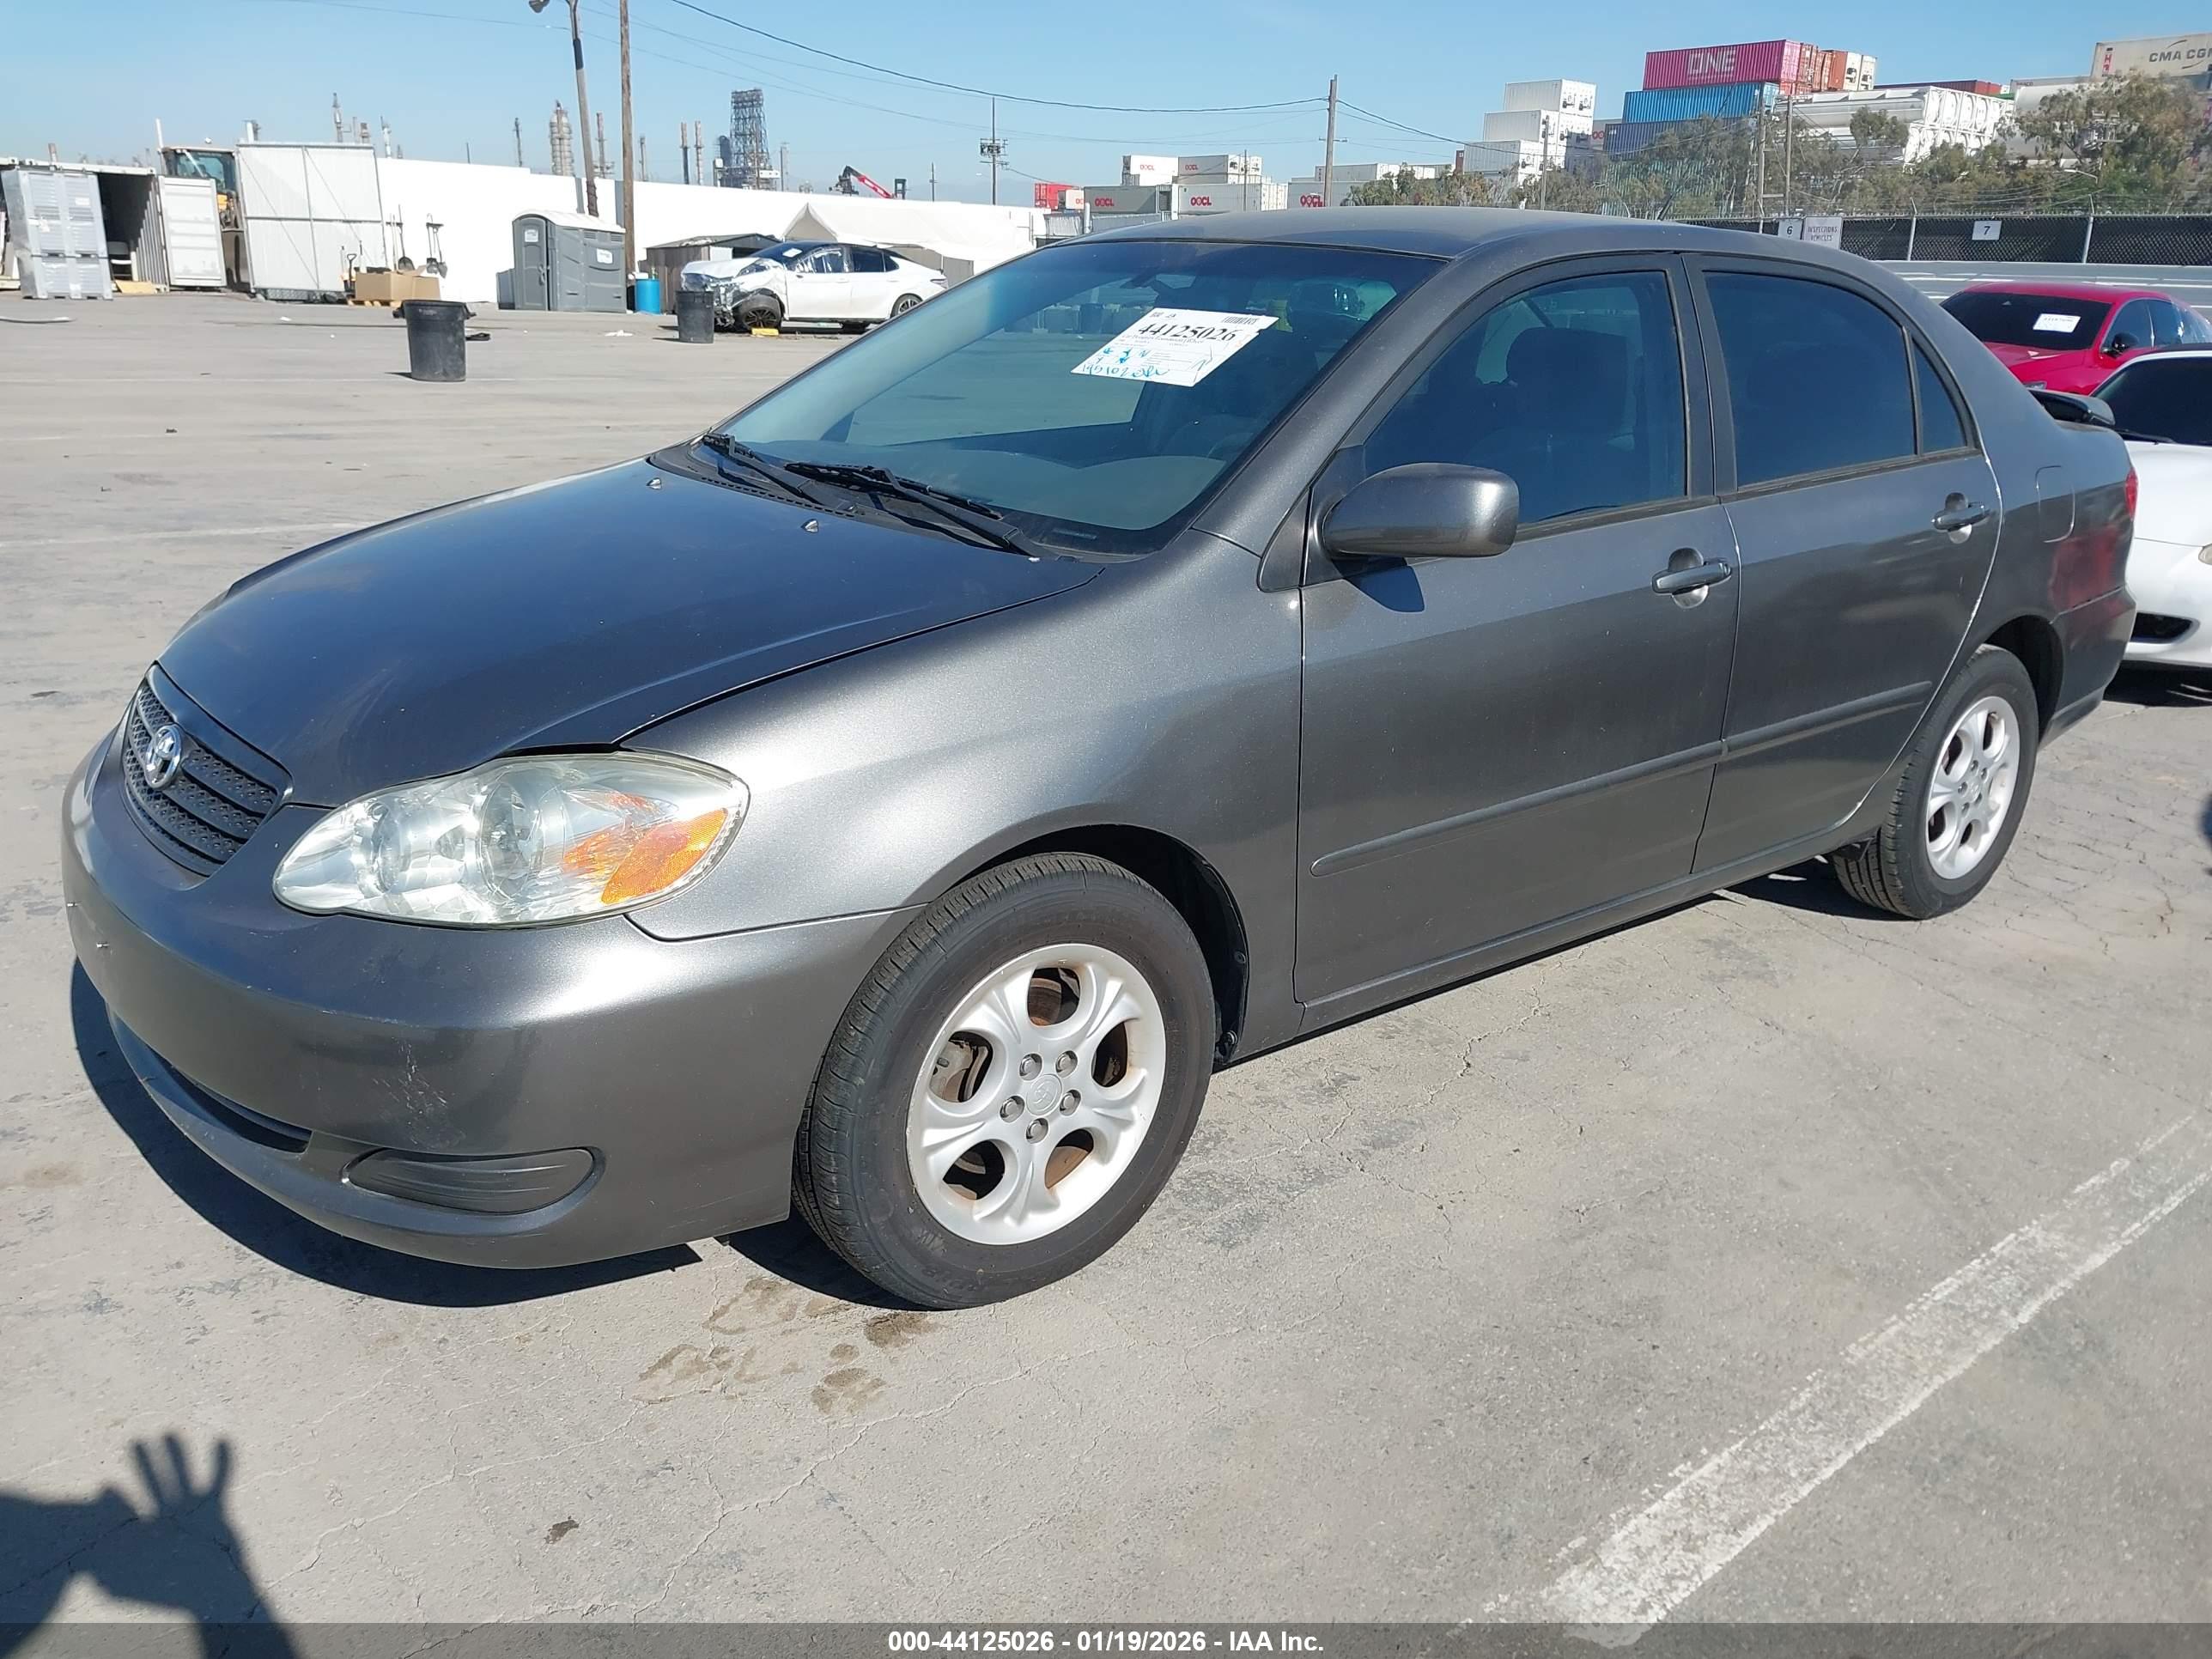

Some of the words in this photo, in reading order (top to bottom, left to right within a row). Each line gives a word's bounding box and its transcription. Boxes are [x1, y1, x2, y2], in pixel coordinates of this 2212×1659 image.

[2148, 51, 2181, 63] CMA
[1687, 50, 1735, 75] ONE
[1094, 197, 1115, 207] OOCL
[1190, 197, 1212, 207] OOCL
[1786, 226, 1794, 235] 6
[1984, 226, 1991, 235] 7
[1138, 323, 1243, 342] 44125026
